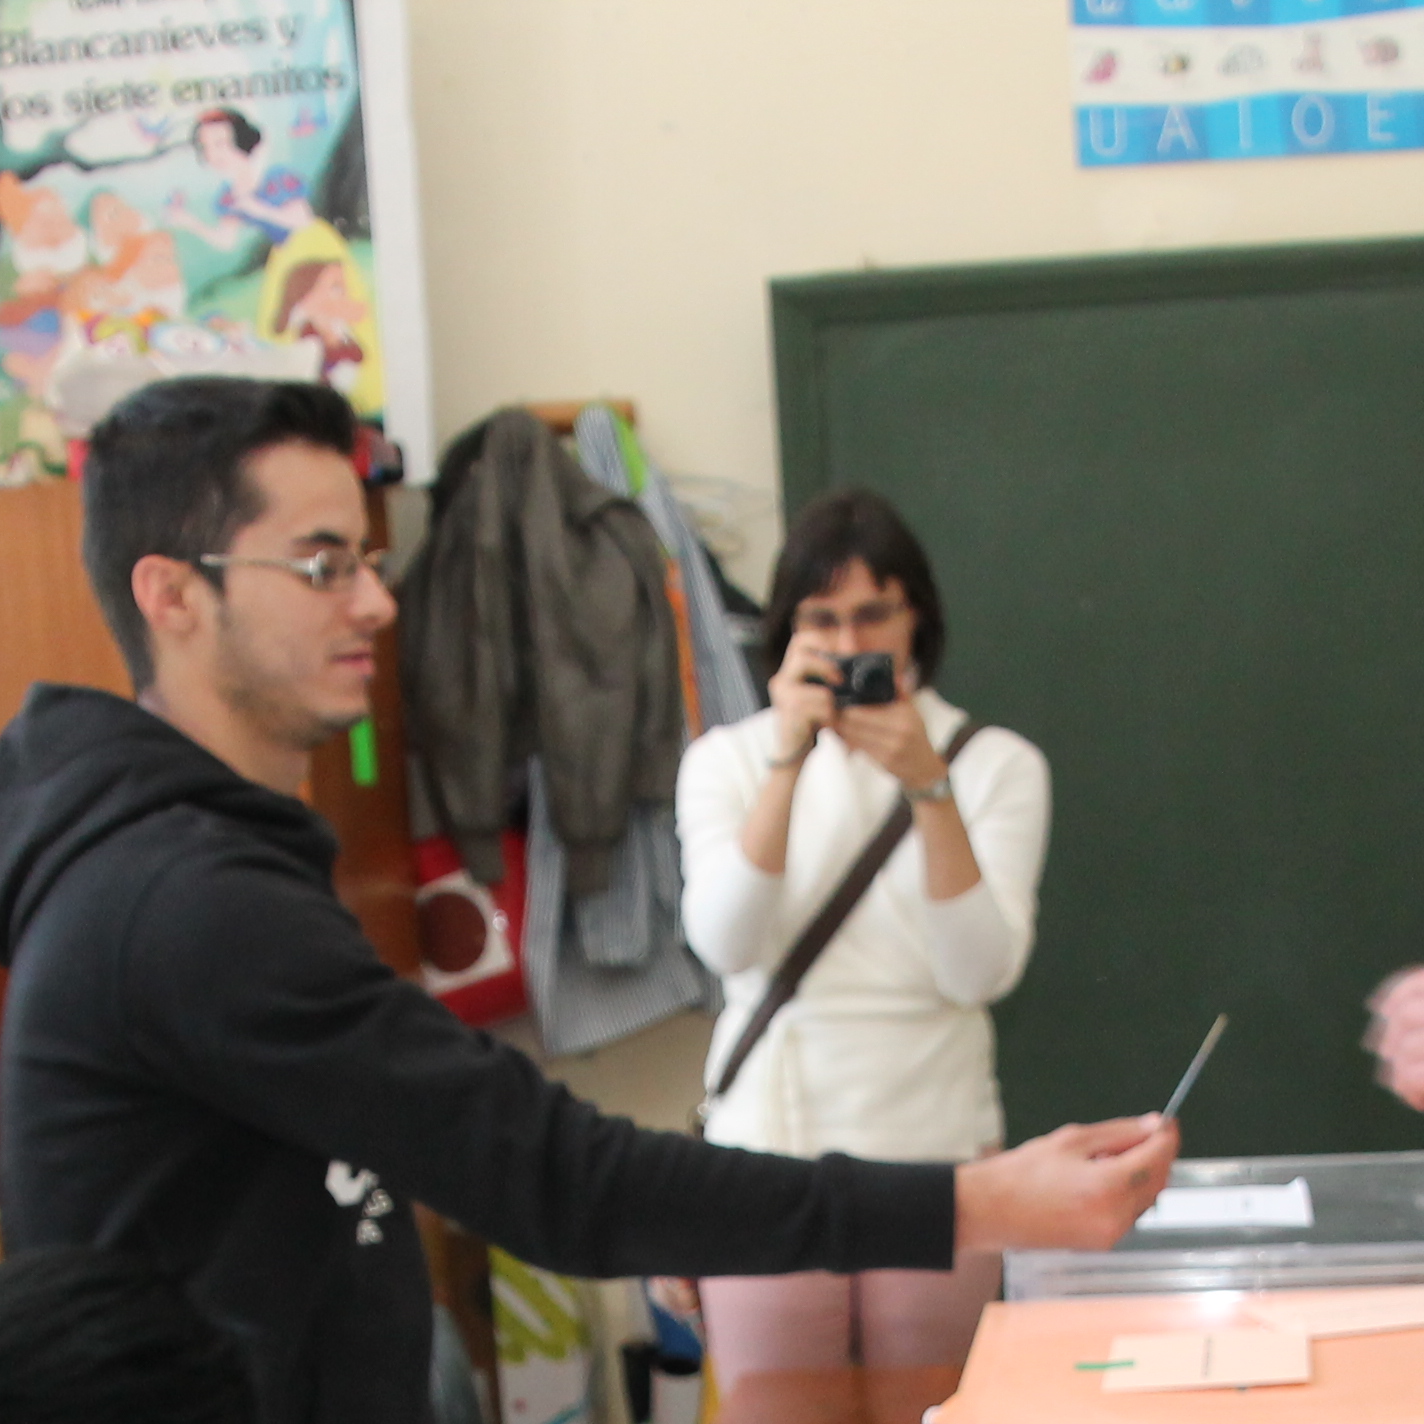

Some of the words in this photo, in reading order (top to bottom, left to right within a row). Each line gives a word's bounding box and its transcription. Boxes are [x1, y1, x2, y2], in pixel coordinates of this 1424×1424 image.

[275, 14, 300, 48] y
[65, 77, 158, 115] siete
[171, 61, 347, 103] enanitos
[1089, 107, 1128, 156] U
[1156, 104, 1199, 154] A
[1290, 93, 1337, 147] O
[1366, 93, 1396, 143] E
